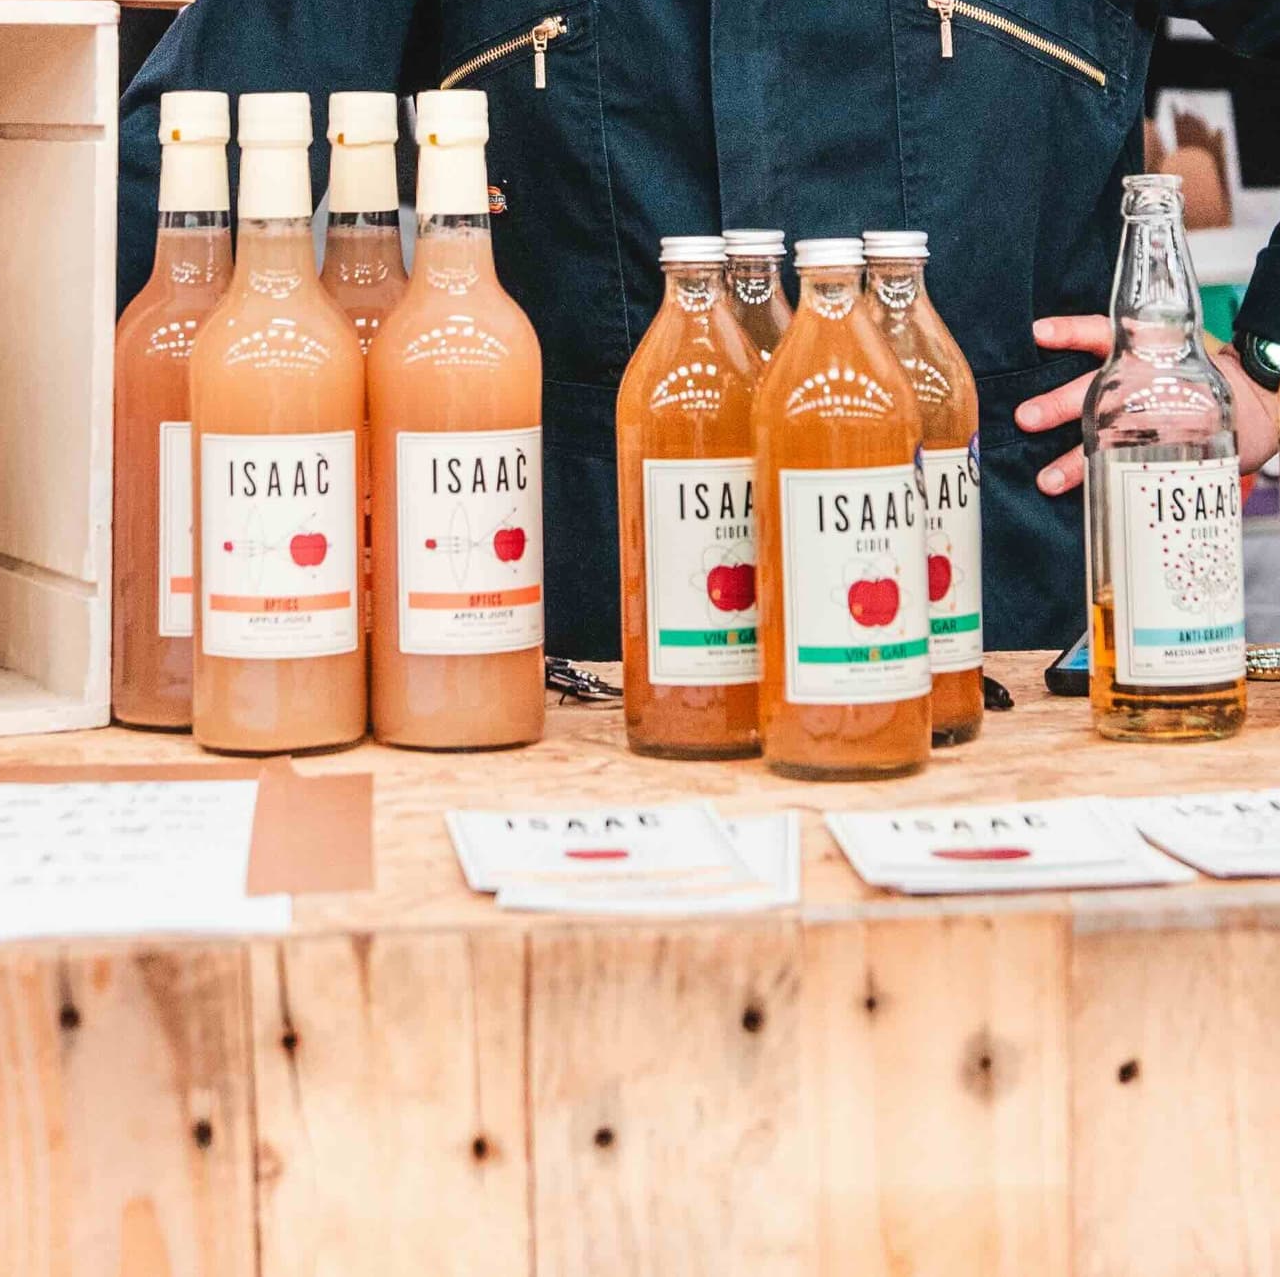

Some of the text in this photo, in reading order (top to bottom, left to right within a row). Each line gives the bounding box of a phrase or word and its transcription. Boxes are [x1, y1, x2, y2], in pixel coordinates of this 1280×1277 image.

[679, 481, 754, 520] ISAA
[715, 525, 749, 540] CIDER
[470, 593, 503, 607] OPTICS
[1179, 627, 1234, 643] ANTI-GRAVITY
[1164, 648, 1206, 658] MEDIUM
